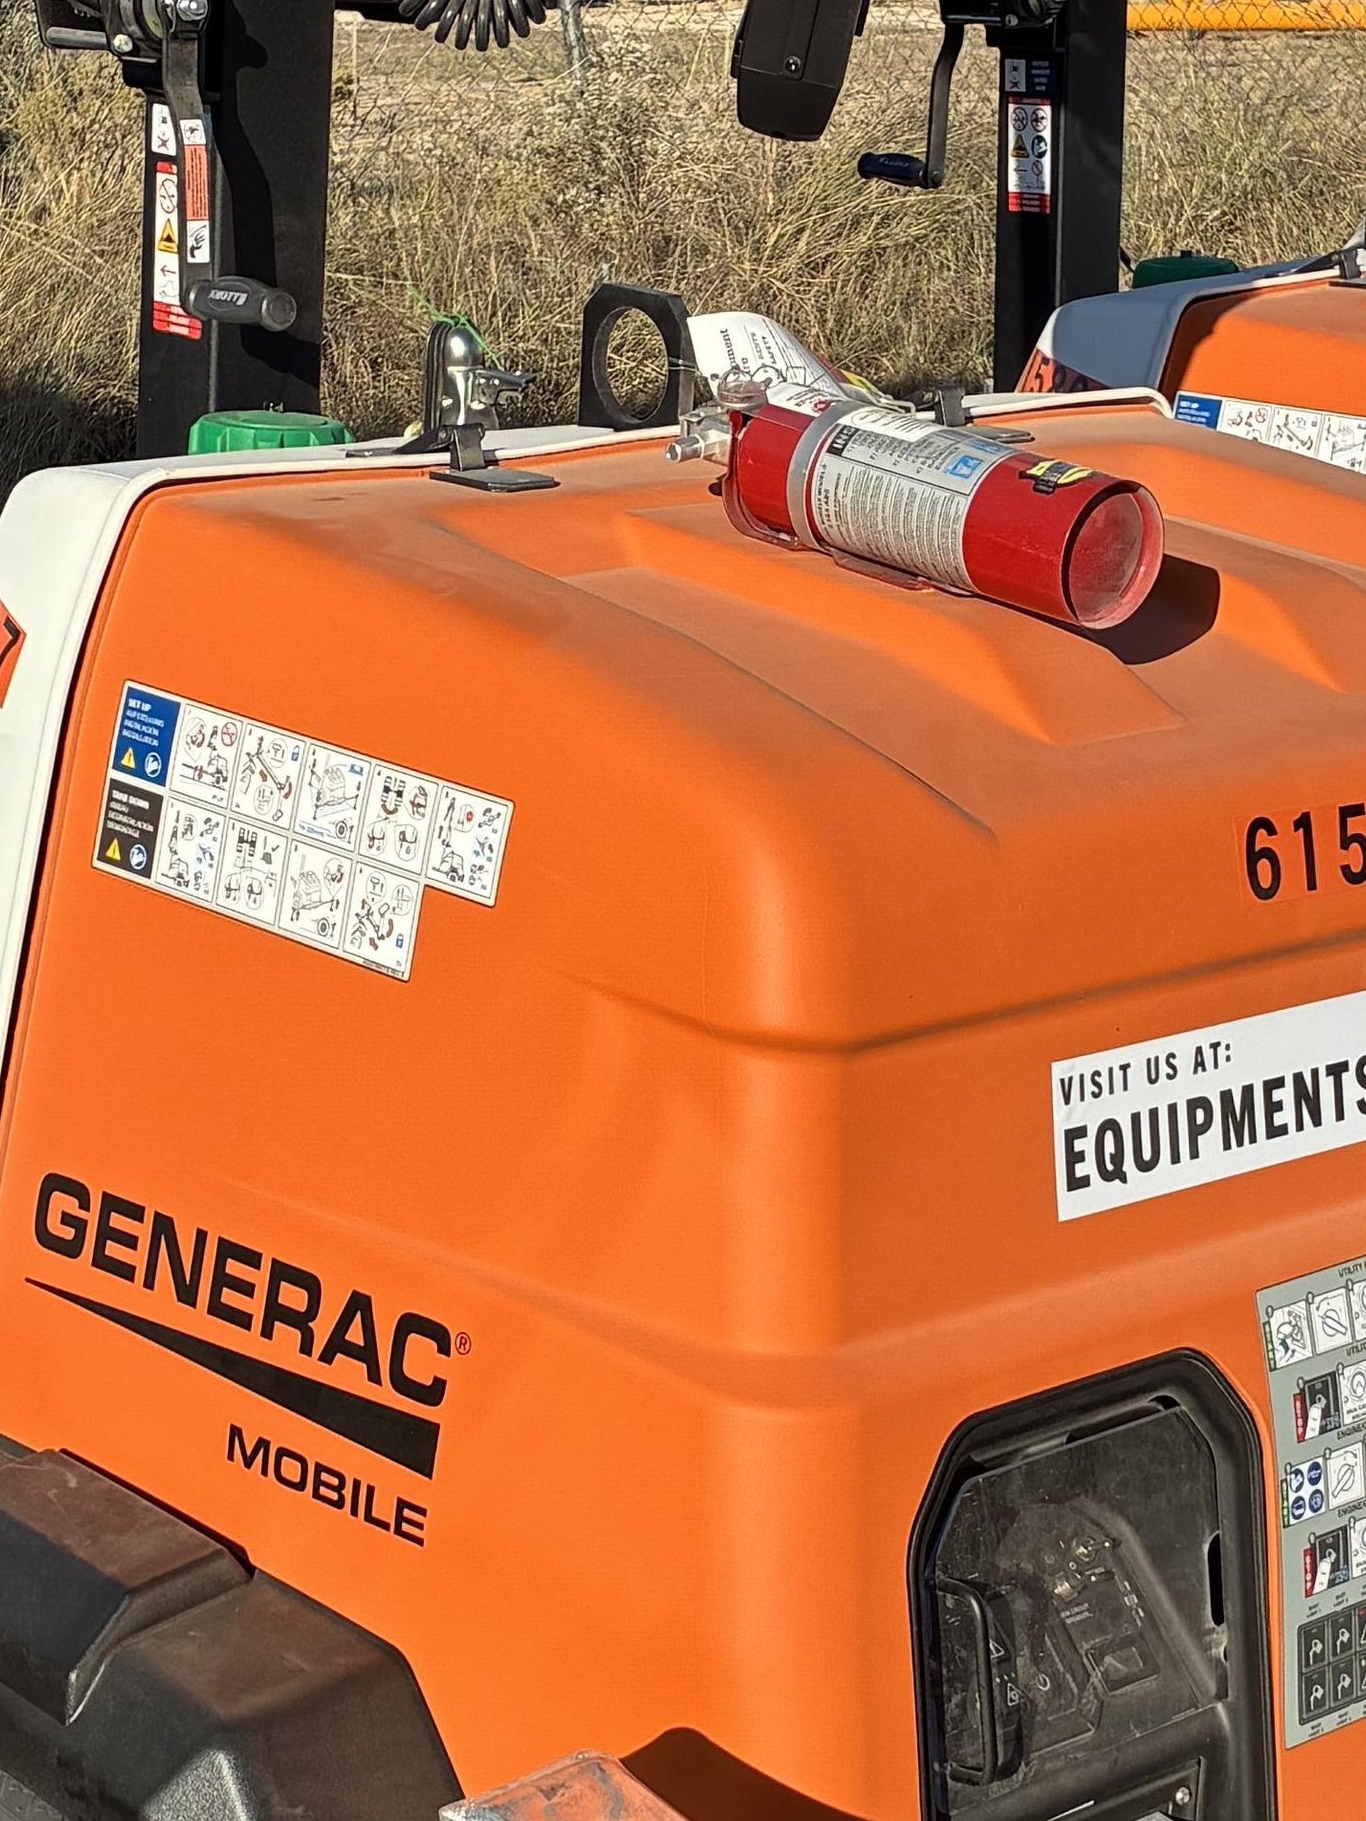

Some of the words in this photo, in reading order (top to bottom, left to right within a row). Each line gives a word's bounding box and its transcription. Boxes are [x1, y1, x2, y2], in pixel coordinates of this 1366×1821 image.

[1060, 1062, 1131, 1107] VISIT
[1146, 1052, 1179, 1086] US
[1192, 1041, 1232, 1076] AT:
[34, 1172, 452, 1407] GENERAC
[227, 1423, 427, 1547] MOBILE
